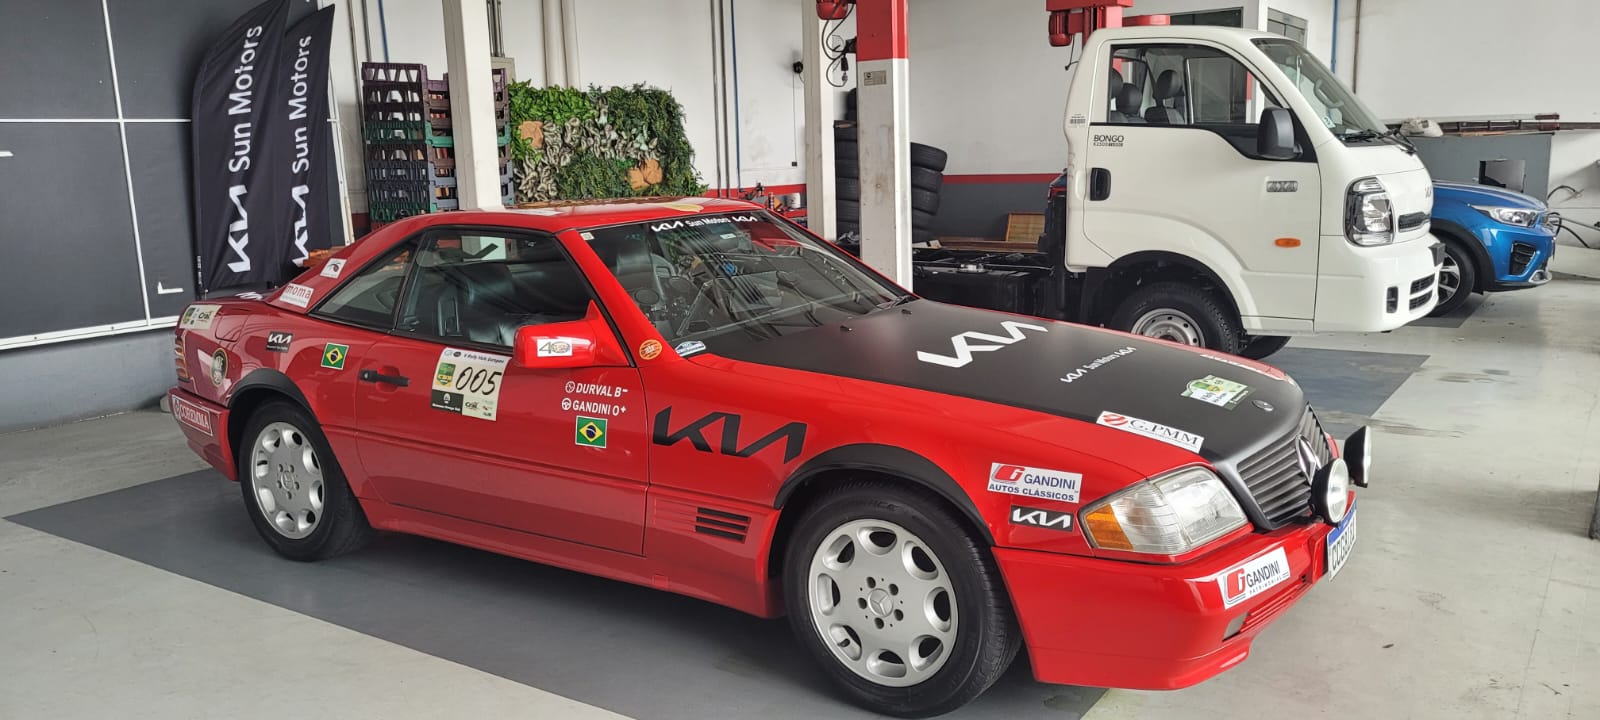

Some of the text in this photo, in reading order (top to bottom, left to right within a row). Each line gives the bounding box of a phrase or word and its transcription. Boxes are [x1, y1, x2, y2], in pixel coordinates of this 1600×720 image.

[228, 25, 263, 116] Motors
[288, 35, 312, 121] Motors
[228, 122, 252, 173] Sun
[292, 126, 310, 175] Sun
[1093, 134, 1125, 143] BONGO
[227, 184, 251, 273] KIA
[651, 220, 685, 233] KIA
[685, 219, 705, 227] Sun
[701, 216, 732, 226] Motors
[286, 285, 311, 299] moma
[268, 333, 292, 344] KIA
[916, 320, 1048, 368] KIA
[455, 366, 503, 396] 005
[576, 383, 612, 397] DURVAL
[572, 400, 611, 415] GANDINI
[652, 406, 808, 464] KIA
[1130, 419, 1198, 445] G.PMM
[989, 483, 1074, 501] AUTOS CLÁSSICOS
[1024, 473, 1076, 490] GANDINI
[1012, 508, 1071, 529] KIA
[1246, 560, 1281, 588] GANDINI
